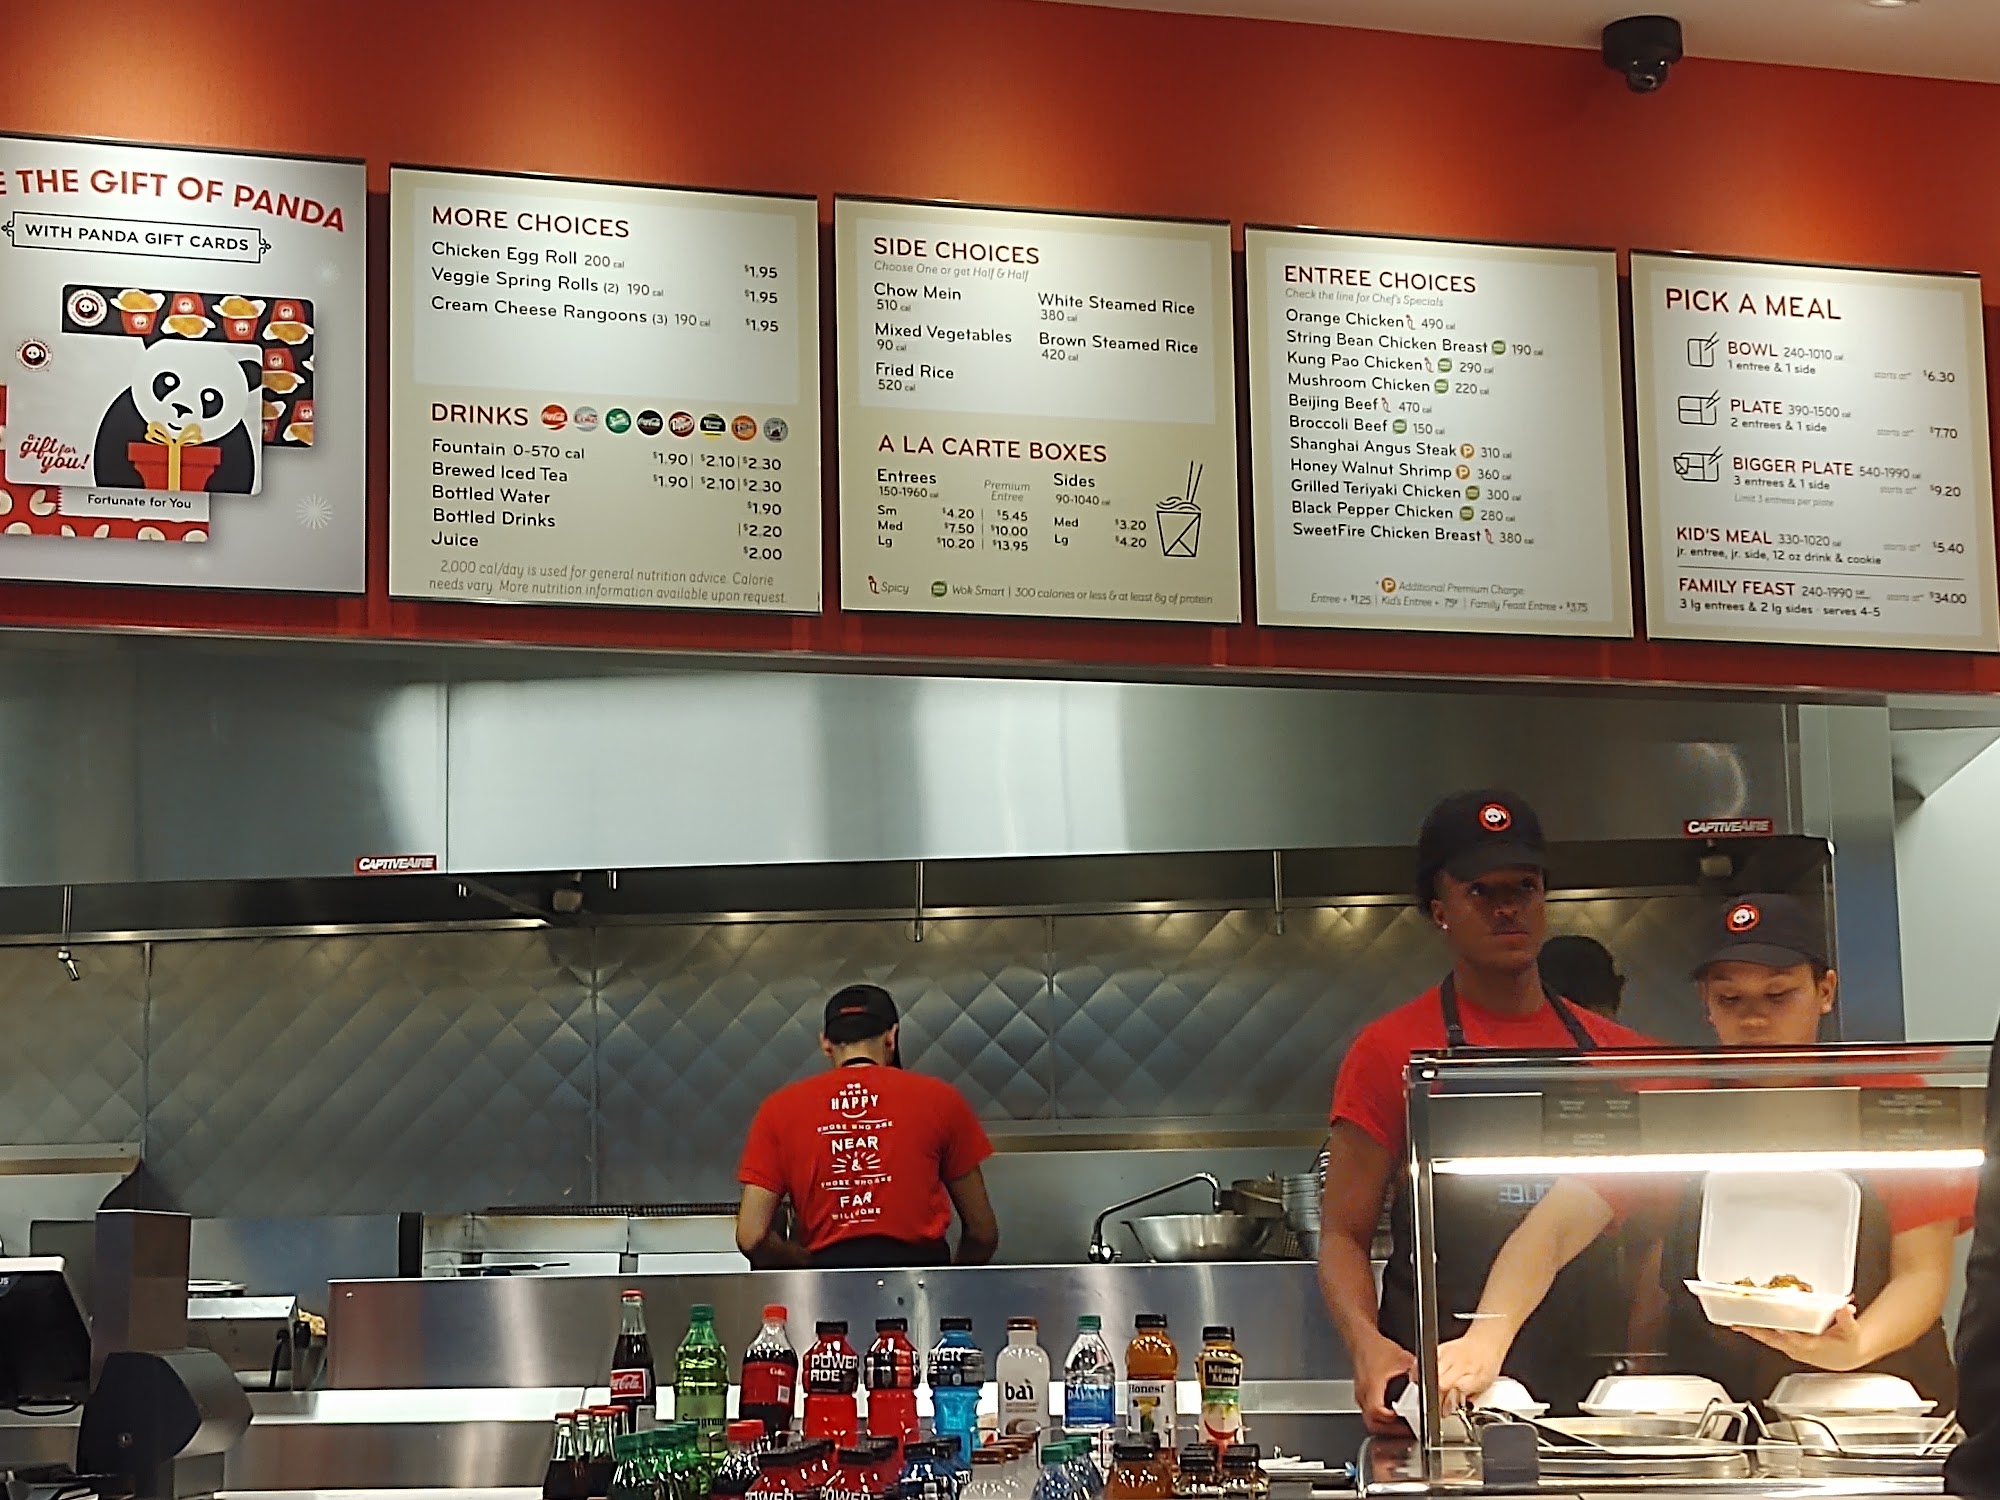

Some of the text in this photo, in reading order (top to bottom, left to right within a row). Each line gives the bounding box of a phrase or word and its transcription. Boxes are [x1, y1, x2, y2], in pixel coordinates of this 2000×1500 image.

[16, 170, 78, 193] THE
[91, 170, 167, 196] GIFT
[178, 177, 223, 203] OF
[234, 186, 344, 231] PANDA
[433, 206, 628, 237] MORE CHOICES
[25, 224, 248, 250] WITH PANDA GIFT CARDS
[432, 242, 777, 278] Chicken Egg Roll 200 $1.95
[874, 237, 1039, 264] SIDE CHOICES
[432, 267, 777, 303] Veggie Spring Rolls (2) 190 $1.95
[1285, 266, 1475, 293] ENTREE CHOICES
[874, 283, 961, 300] Chow Mein
[432, 296, 778, 332] Cream Cheese Rangoons (3) 190 $1.95
[1038, 293, 1194, 314] White Steamed Rice
[1667, 288, 1841, 319] PICK A MEAL
[1286, 309, 1403, 327] Orange Chicken
[876, 323, 1011, 342] Mixed Vegetables
[1040, 332, 1198, 353] Brown Steamed Rice
[1287, 330, 1487, 353] String Bean Chicken Breast
[876, 362, 953, 379] Fried Rice
[1288, 351, 1422, 370] Kung Pao Chicken
[1728, 341, 1778, 357] BOWL
[1923, 370, 1955, 382] $6.30
[1289, 373, 1429, 391] Mushroom Chicken
[1289, 394, 1378, 411] Beijing Beef
[432, 403, 528, 426] DRINKS
[1290, 415, 1387, 431] Broccoli Beef
[1731, 399, 1782, 414] PLATE
[1930, 427, 1957, 439] $7.70
[20, 434, 58, 460] gift
[57, 444, 76, 459] for
[433, 439, 781, 470] Fountain 0-570 cal $1.90 $2.10 $2.30
[879, 435, 1106, 462] A LA CARTE BOXES
[1290, 436, 1456, 456] Shanghai Angus Steak
[41, 451, 90, 474] you!
[1291, 458, 1451, 480] Honey Walnut Shrimp
[433, 462, 781, 492] Brewed Iced Tea $1.90 $2.10 $2.30
[878, 469, 1095, 487] Entrees Sides
[1734, 457, 1795, 472] BIGGER
[1802, 461, 1853, 476] PLATE
[1930, 485, 1961, 497] $9.20
[880, 486, 1099, 505] 150-1960 90-1040
[1292, 479, 1460, 498] Grilled Teriyaki Chicken
[88, 494, 191, 508] Fortunate for You
[433, 485, 781, 515] Bottled Water $1.90
[1292, 501, 1453, 518] Black Pepper Chicken
[434, 508, 782, 537] Bottled Drinks $2.20
[878, 505, 1027, 521] Sm $4.20 $5.45
[1055, 517, 1146, 530] Med $3.20
[878, 520, 1028, 536] Med $7.50 $10.00
[1293, 522, 1480, 541] SweetFire Chicken Breast
[432, 531, 782, 560] Juice $2.00
[879, 535, 1028, 551] Lg $10.20 $13.95
[1055, 534, 1146, 548] Lg $4.20
[1677, 527, 1720, 542] KID'S
[1726, 530, 1772, 544] MEAL
[1933, 541, 1964, 554] $5.40
[881, 581, 909, 595] Spicy
[952, 585, 1004, 596] Wok Smart
[1680, 578, 1736, 593] FAMILY
[1743, 581, 1795, 595] FEAST
[1930, 592, 1967, 604] $34.00
[831, 1095, 878, 1110] HAPPY
[832, 1136, 879, 1155] NEAR
[840, 1192, 872, 1208] FAR
[811, 1353, 858, 1369] POWER
[811, 1369, 840, 1381] ADE
[1005, 1379, 1033, 1400] bai
